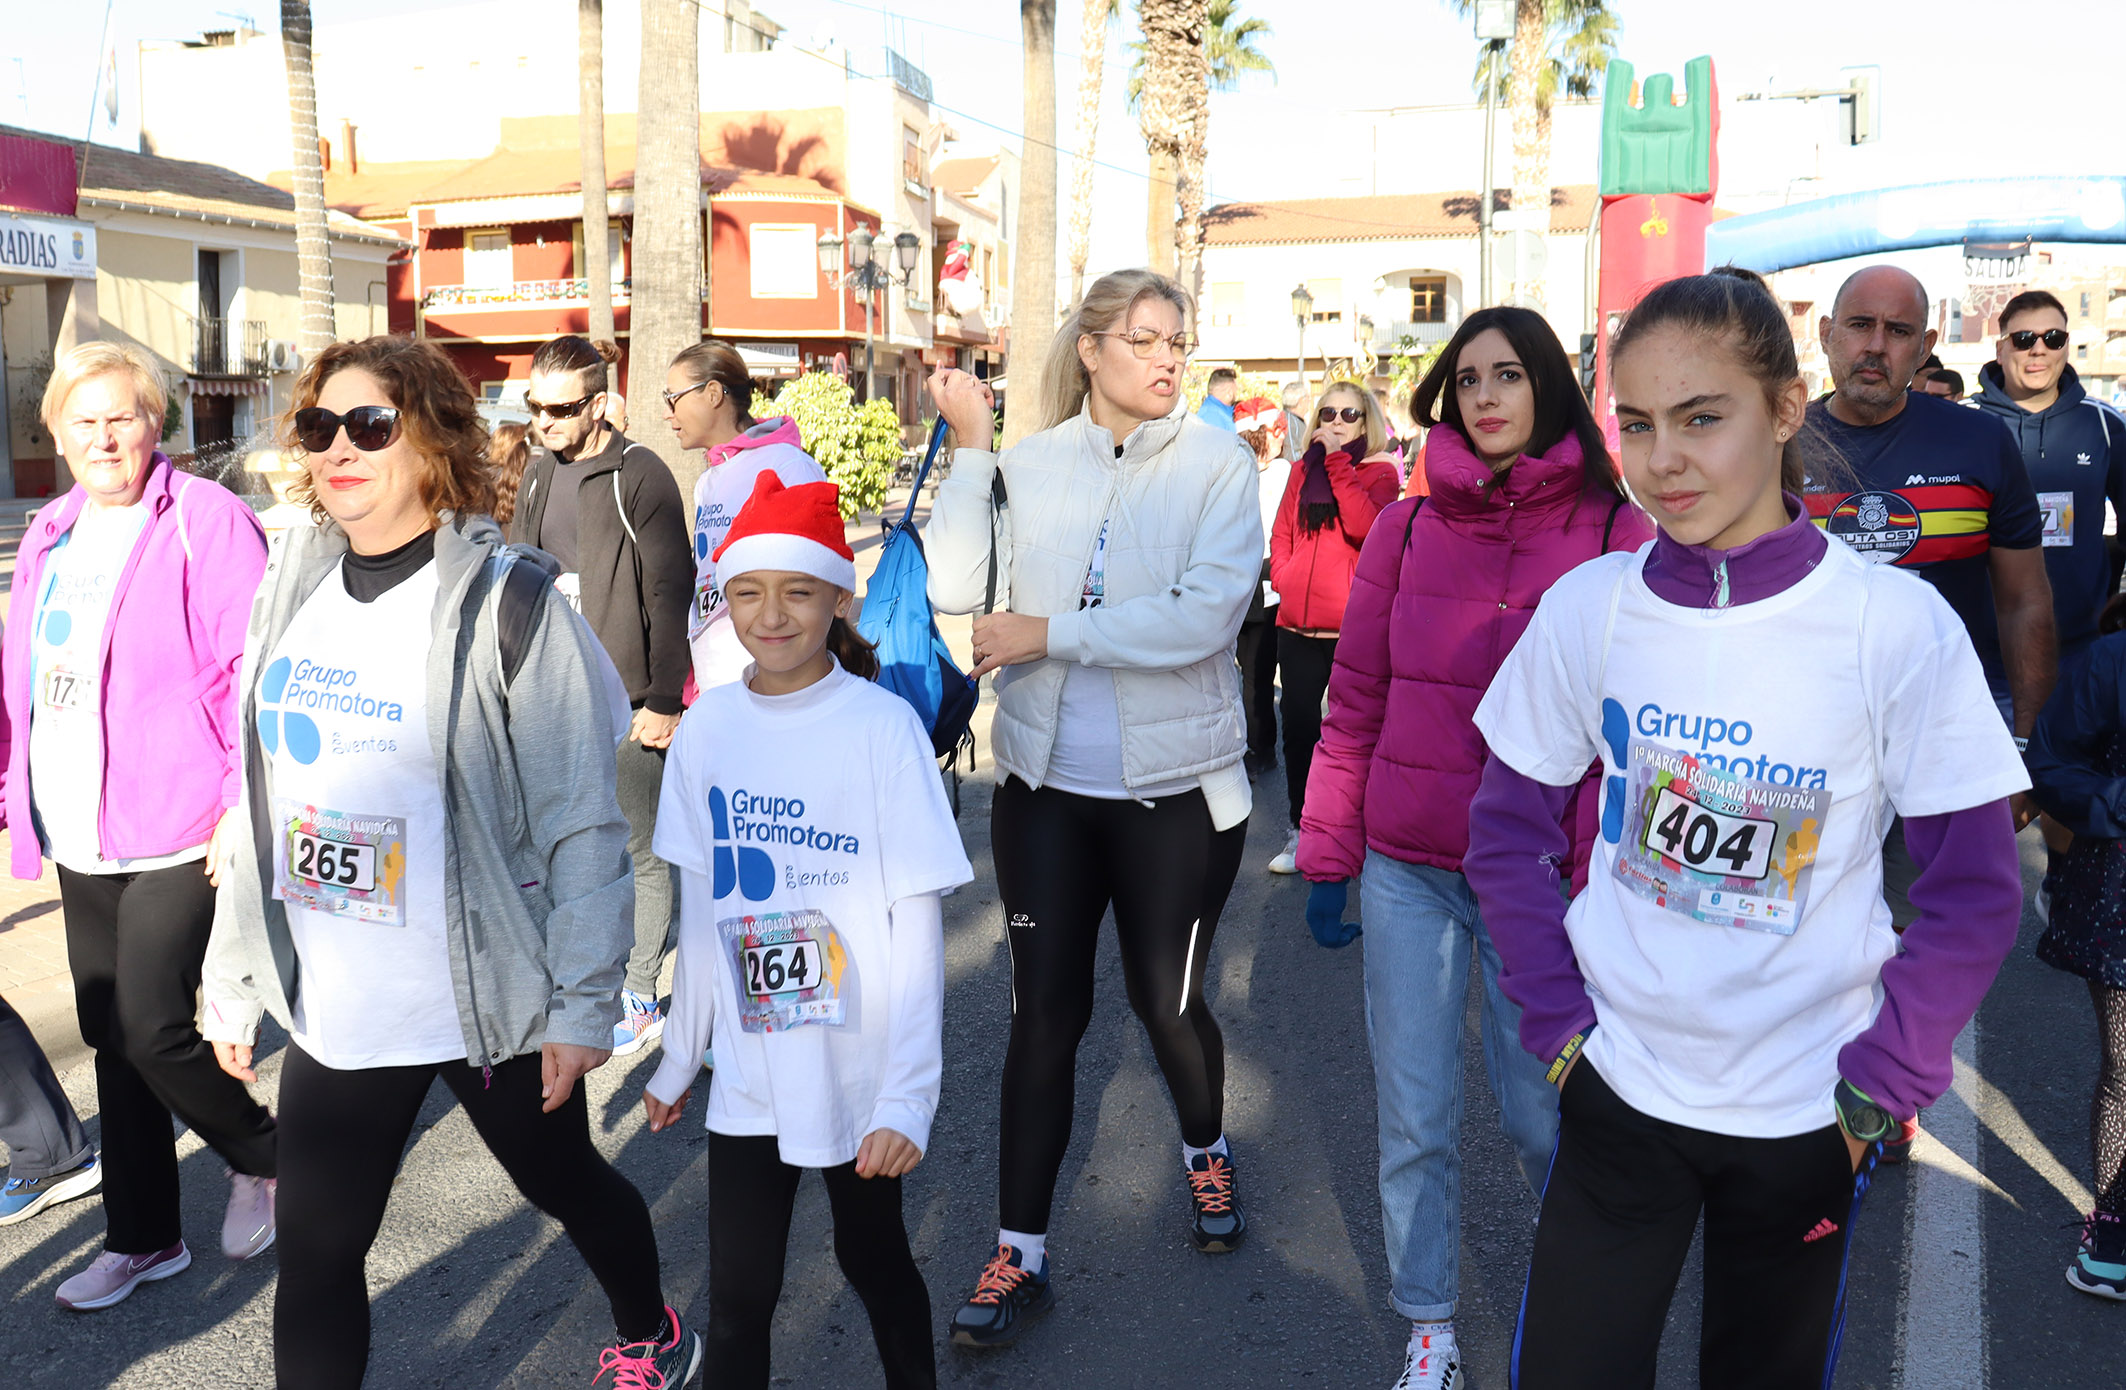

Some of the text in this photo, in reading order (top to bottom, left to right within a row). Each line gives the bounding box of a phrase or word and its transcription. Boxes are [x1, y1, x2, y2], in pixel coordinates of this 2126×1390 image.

[1964, 256, 2027, 279] SALIDA
[1928, 473, 1961, 486] mupol
[1885, 530, 1915, 541] 091
[702, 589, 723, 613] 42
[294, 659, 357, 690] Grupo
[285, 682, 403, 722] Promotora
[1636, 703, 1753, 750] Grupo
[1645, 748, 1688, 782] MARCHA
[1688, 766, 1748, 804] SOLIDARIA
[1749, 788, 1816, 812] NAVIDEÑA
[731, 788, 806, 822] Grupo
[1703, 794, 1714, 805] 12
[1720, 801, 1751, 815] 2023
[732, 815, 860, 855] Promotora
[1656, 802, 1758, 871] 404
[297, 838, 360, 885] 265
[747, 946, 809, 992] 264
